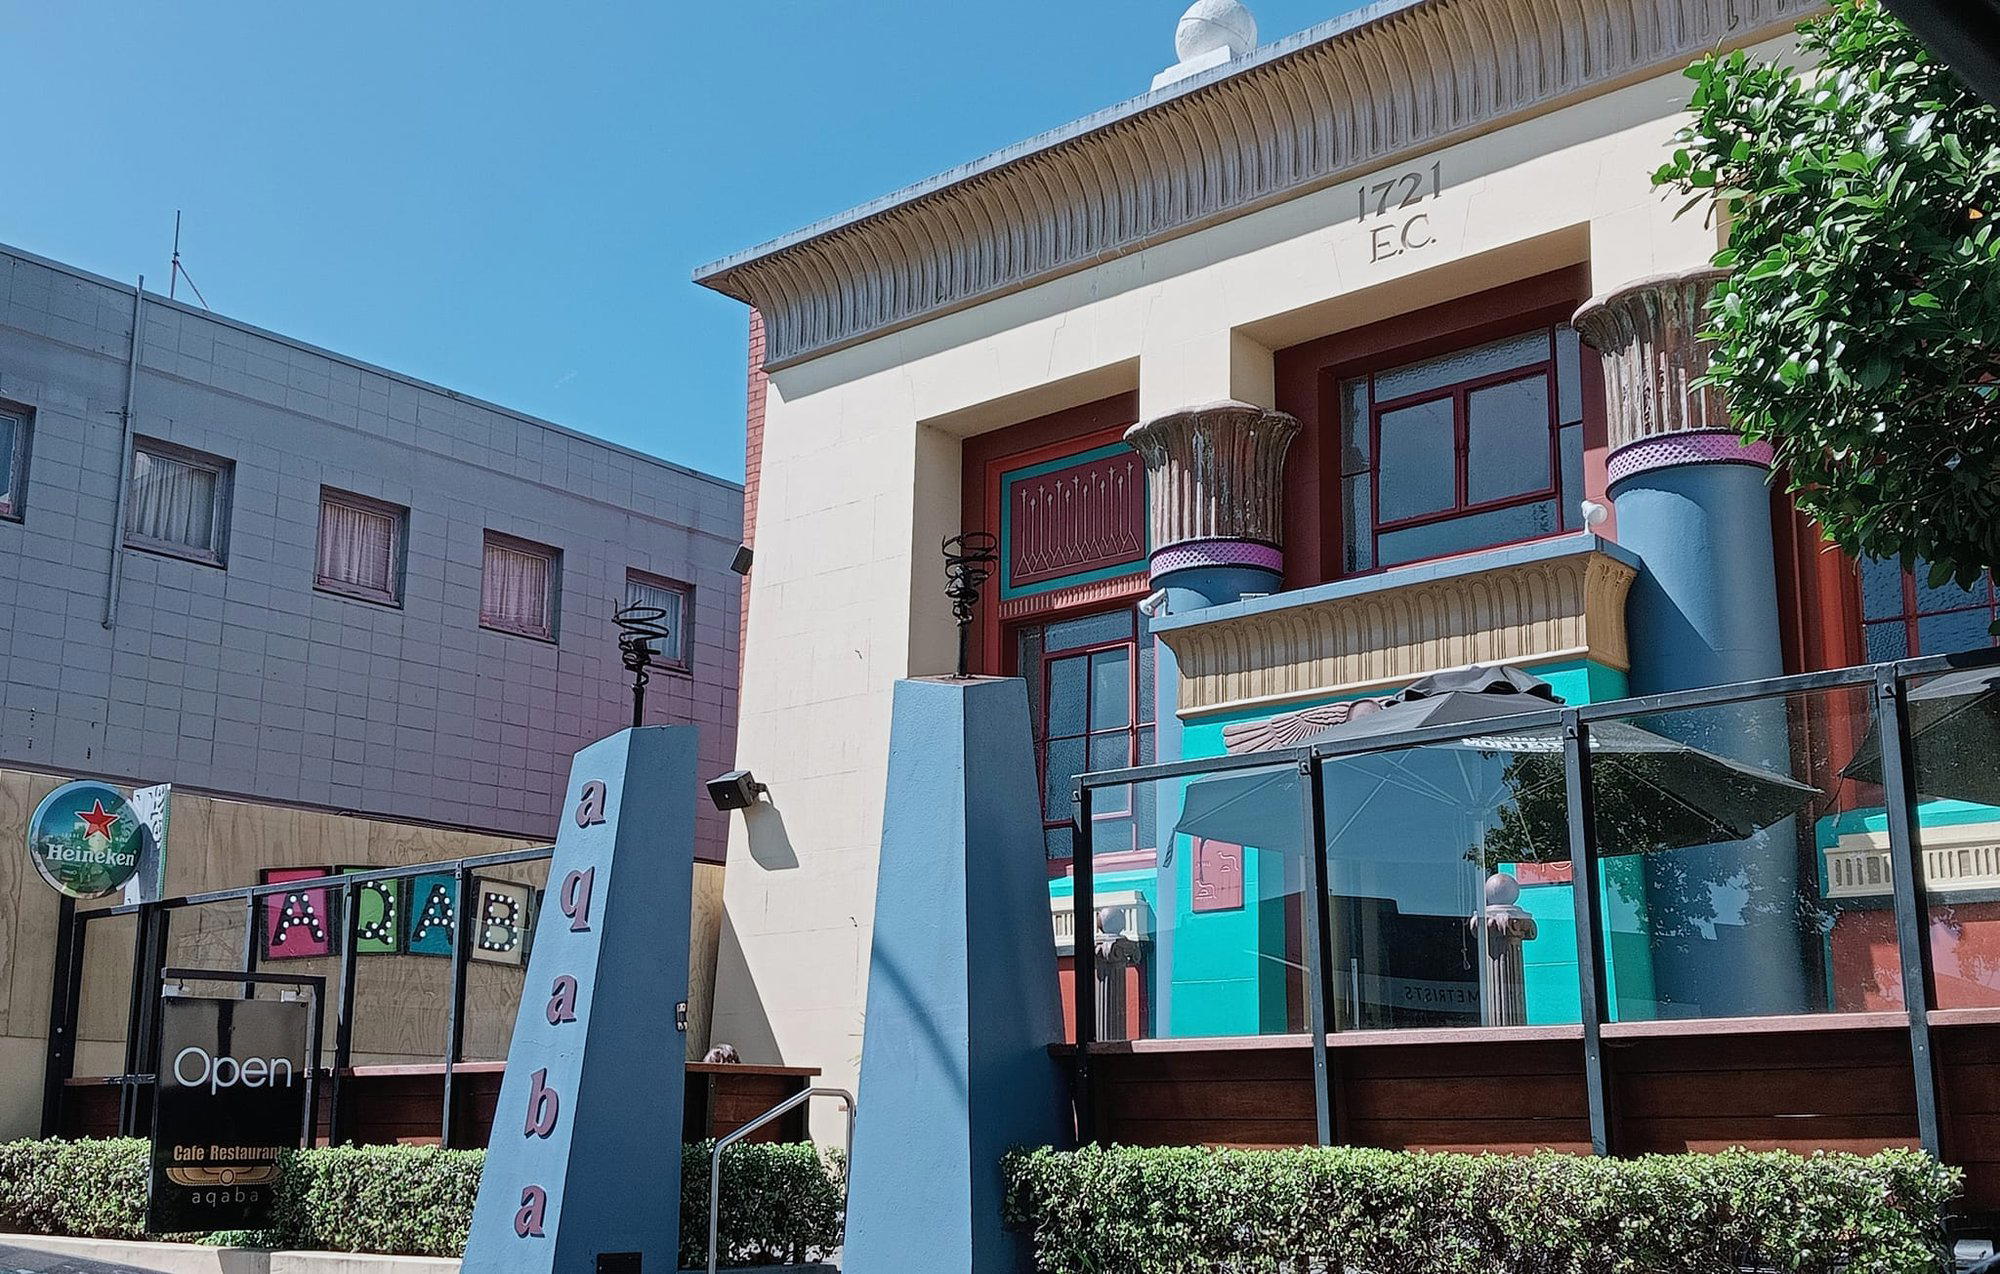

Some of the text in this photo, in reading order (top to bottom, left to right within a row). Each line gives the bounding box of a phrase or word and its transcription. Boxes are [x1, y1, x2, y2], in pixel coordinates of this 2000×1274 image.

[1358, 160, 1441, 224] 1721
[1369, 213, 1437, 264] E.C.
[46, 843, 135, 867] Heineken
[514, 779, 607, 1239] aqaba
[174, 1046, 293, 1096] Open
[173, 1145, 205, 1161] Cafe
[191, 1187, 259, 1208] aqaba
